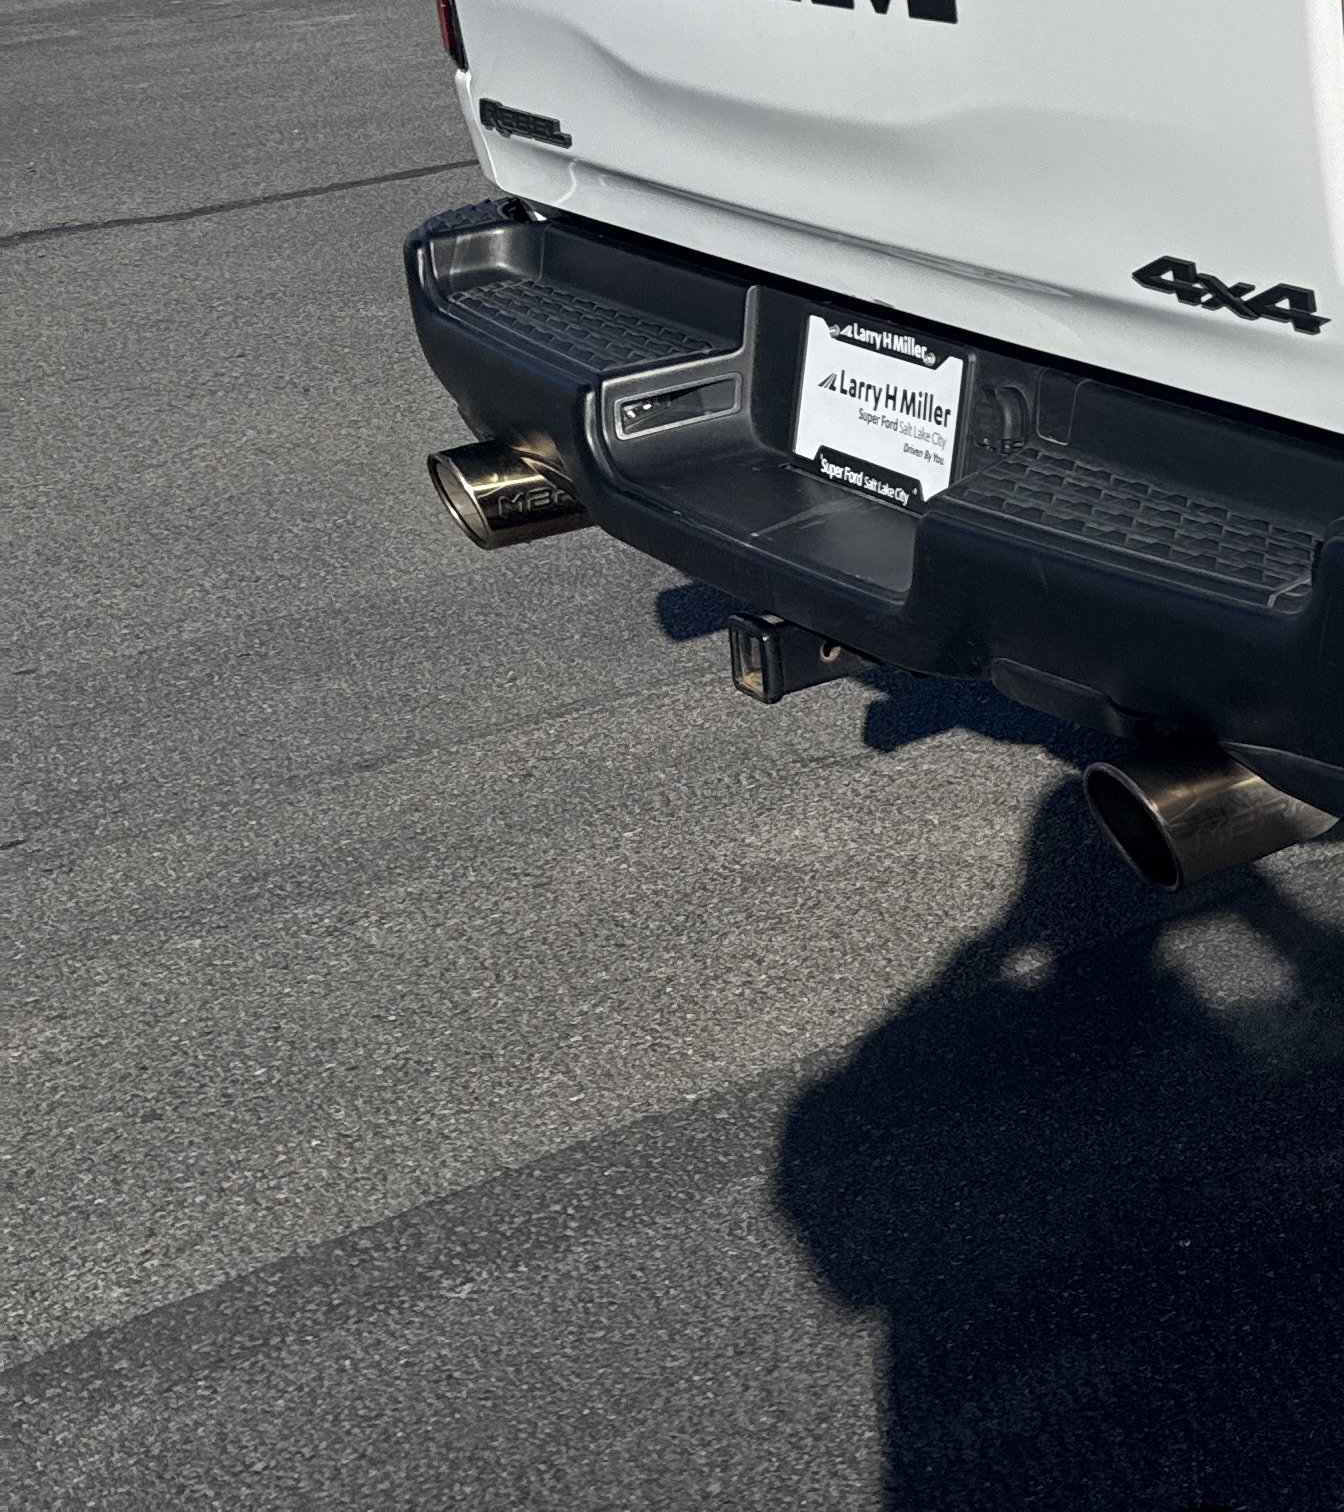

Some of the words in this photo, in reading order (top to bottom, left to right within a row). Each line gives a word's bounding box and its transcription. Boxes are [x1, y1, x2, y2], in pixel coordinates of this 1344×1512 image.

[853, 322, 882, 350] Larry
[882, 331, 892, 349] H
[893, 334, 927, 360] Miller
[840, 369, 882, 411] Larry
[884, 383, 897, 411] H
[900, 388, 951, 428] Miller
[858, 408, 880, 428] Super
[881, 412, 898, 432] Ford
[899, 417, 912, 436] Salt
[913, 421, 930, 443] Lake
[932, 431, 947, 451] City
[821, 458, 844, 481] Super
[844, 467, 863, 486] Ford
[864, 474, 878, 490] Salt
[878, 479, 894, 496] Lake
[894, 487, 910, 506] City
